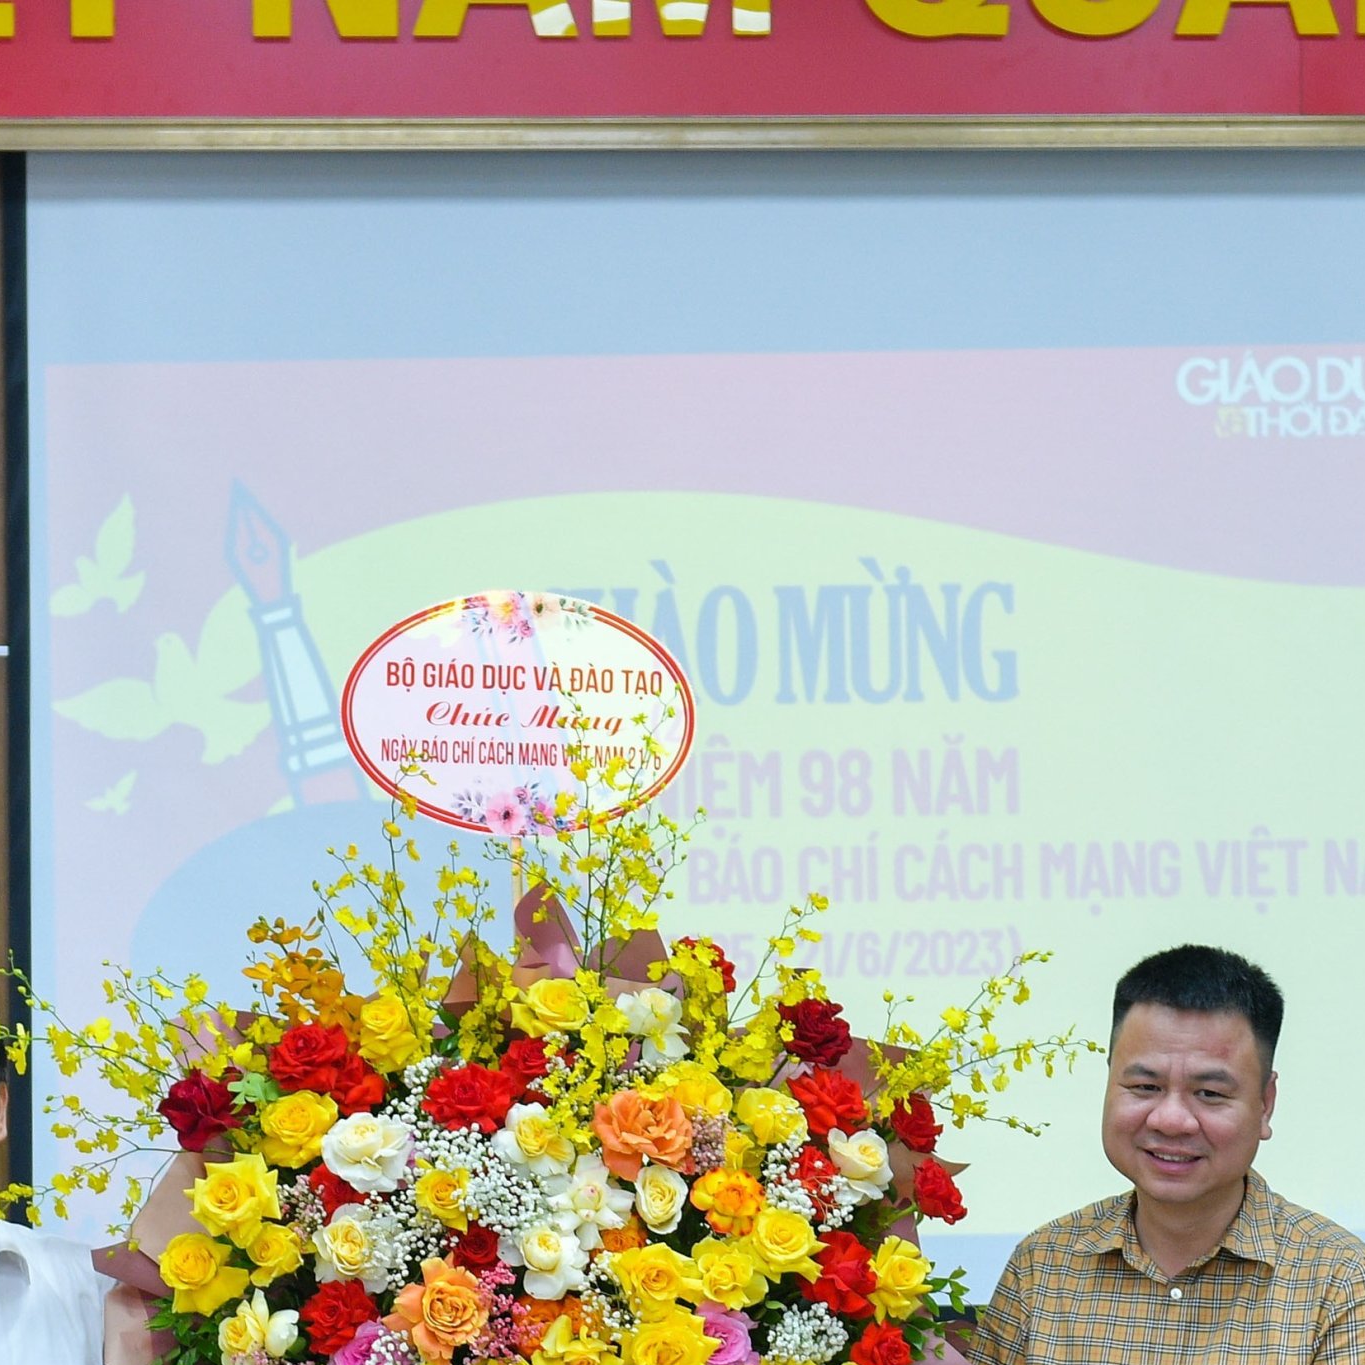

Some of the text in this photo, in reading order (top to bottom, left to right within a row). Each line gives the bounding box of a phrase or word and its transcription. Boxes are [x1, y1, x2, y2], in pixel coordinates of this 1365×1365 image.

[1176, 350, 1311, 405] GIÁO
[773, 556, 1021, 706] MỪNG
[386, 657, 663, 700] BỘ GIÁO DỤC VÀ ĐÀO TẠO
[426, 701, 510, 727] Chúc
[381, 734, 418, 762] NGÀY
[421, 735, 448, 764] BÁO
[452, 736, 475, 764] CHÍ
[478, 736, 514, 765] CÁCH
[519, 742, 557, 771] MẠNG
[798, 750, 873, 818] 98
[894, 734, 1020, 817] NĂM
[687, 833, 781, 905] BÁO
[797, 831, 879, 903] CHÍ
[893, 831, 1023, 902] CÁCH
[1040, 840, 1181, 916] MẠNG
[1202, 825, 1307, 914] VIỆT
